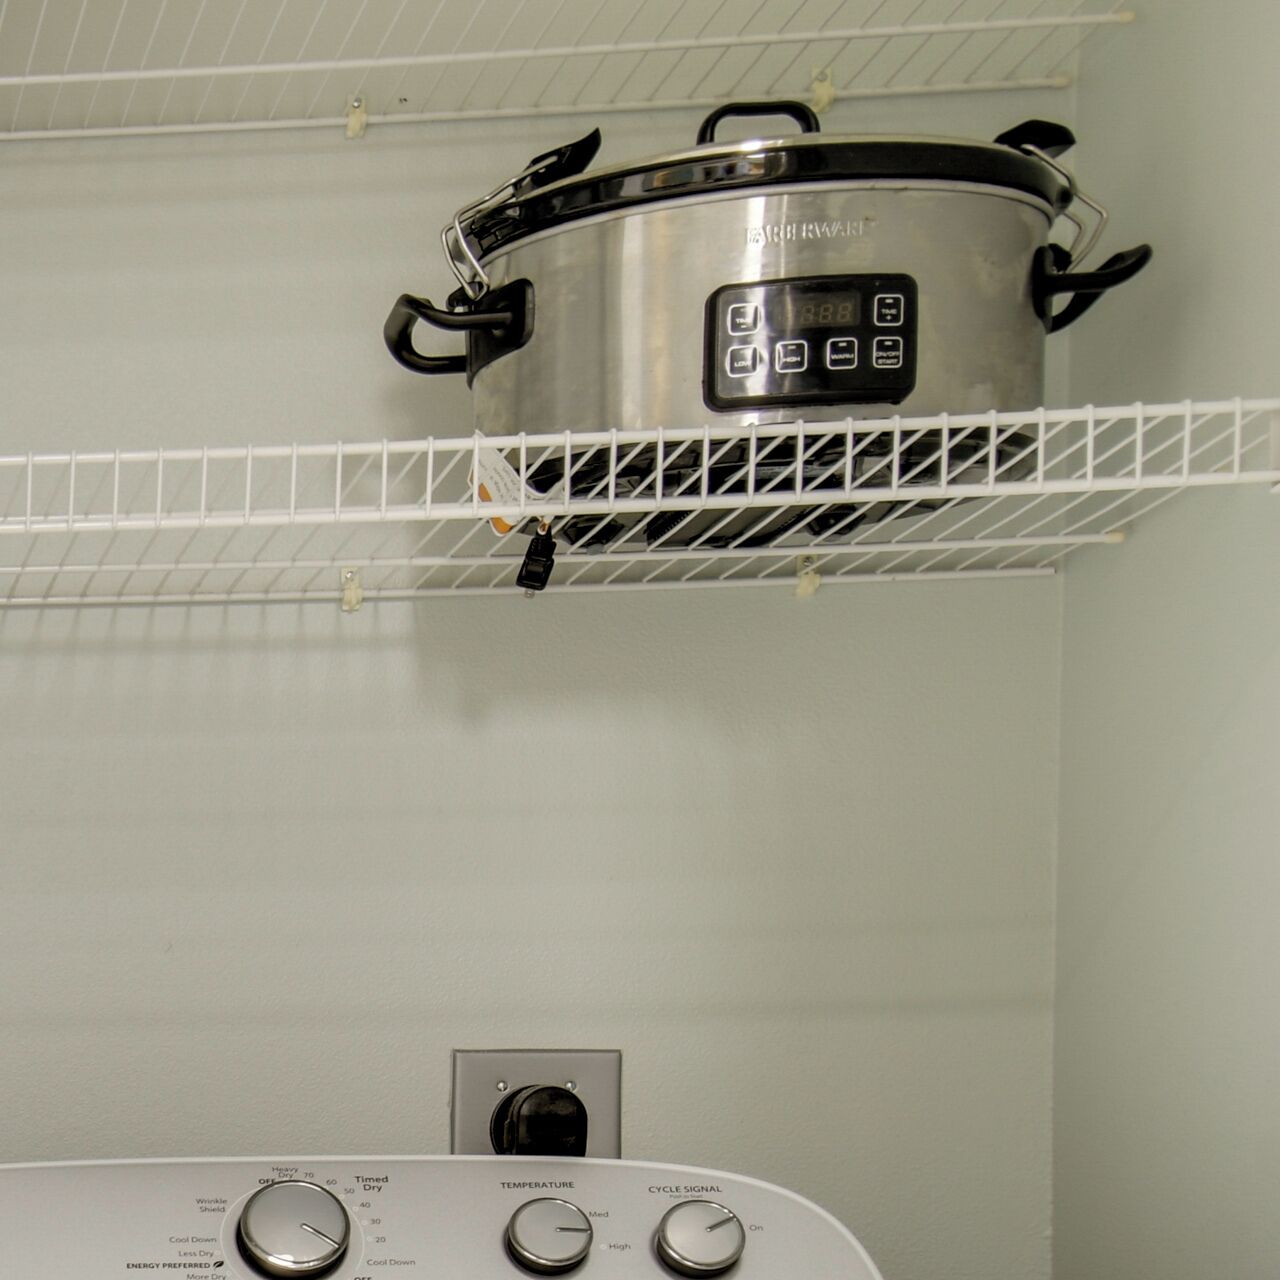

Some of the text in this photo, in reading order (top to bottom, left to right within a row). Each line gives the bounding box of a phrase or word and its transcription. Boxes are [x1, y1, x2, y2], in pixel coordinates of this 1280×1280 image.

[830, 352, 855, 360] WARM
[272, 1166, 299, 1175] Heavy
[278, 1171, 294, 1180] Dry
[354, 1175, 389, 1184] Timed
[258, 1178, 277, 1186] OFF
[326, 1178, 338, 1186] 60
[500, 1181, 576, 1190] TEMPERATURE
[344, 1187, 355, 1195] 50
[363, 1183, 383, 1193] Dry
[647, 1185, 723, 1194] CYCLE SIGNAL
[196, 1197, 228, 1205] Wrinkle
[359, 1201, 371, 1209] 40
[199, 1205, 226, 1213] Shield
[589, 1210, 610, 1218] Med
[370, 1218, 382, 1226] 30
[748, 1224, 764, 1232] On
[168, 1235, 217, 1244] Cool Down
[608, 1242, 632, 1251] High
[198, 1249, 215, 1258] Dry
[126, 1262, 160, 1270] ENERGY
[366, 1258, 416, 1266] Cool Down
[186, 1273, 227, 1280] More Dry
